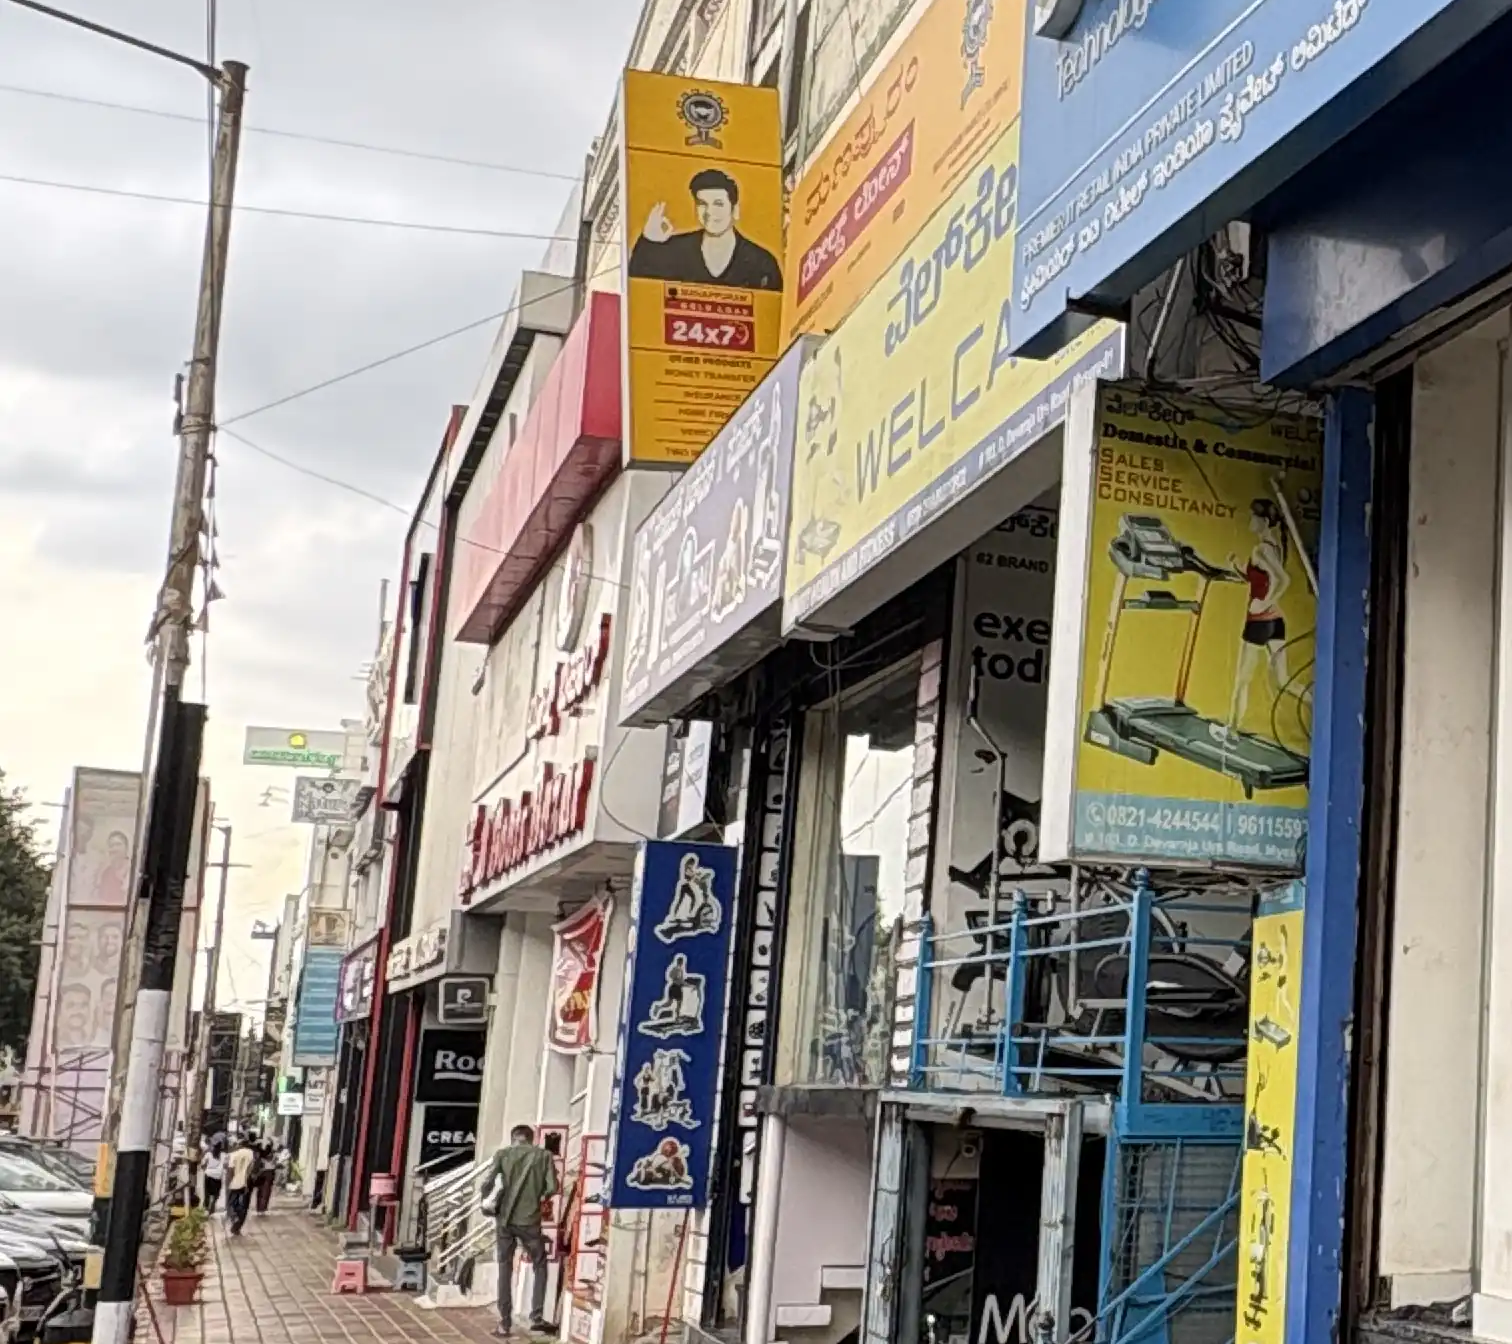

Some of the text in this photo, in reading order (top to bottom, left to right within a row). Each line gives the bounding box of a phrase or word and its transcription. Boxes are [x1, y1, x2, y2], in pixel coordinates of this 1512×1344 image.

[1113, 140, 1144, 186] INDIA
[1145, 87, 1198, 152] PRIVATE
[1199, 40, 1255, 105] LIMITED
[672, 320, 736, 346] 24x7
[855, 304, 1014, 506] WELCA
[1103, 423, 1317, 472] Domestic & Commercial
[1270, 424, 1320, 444] WELC
[1100, 448, 1164, 473] SALES
[1099, 465, 1182, 494] SERVICE
[1098, 483, 1238, 519] CONSULTANCY
[974, 611, 1050, 646] exe
[973, 644, 1050, 684] tod
[1107, 806, 1220, 833] 0821-4244544
[427, 1130, 476, 1144] CREA
